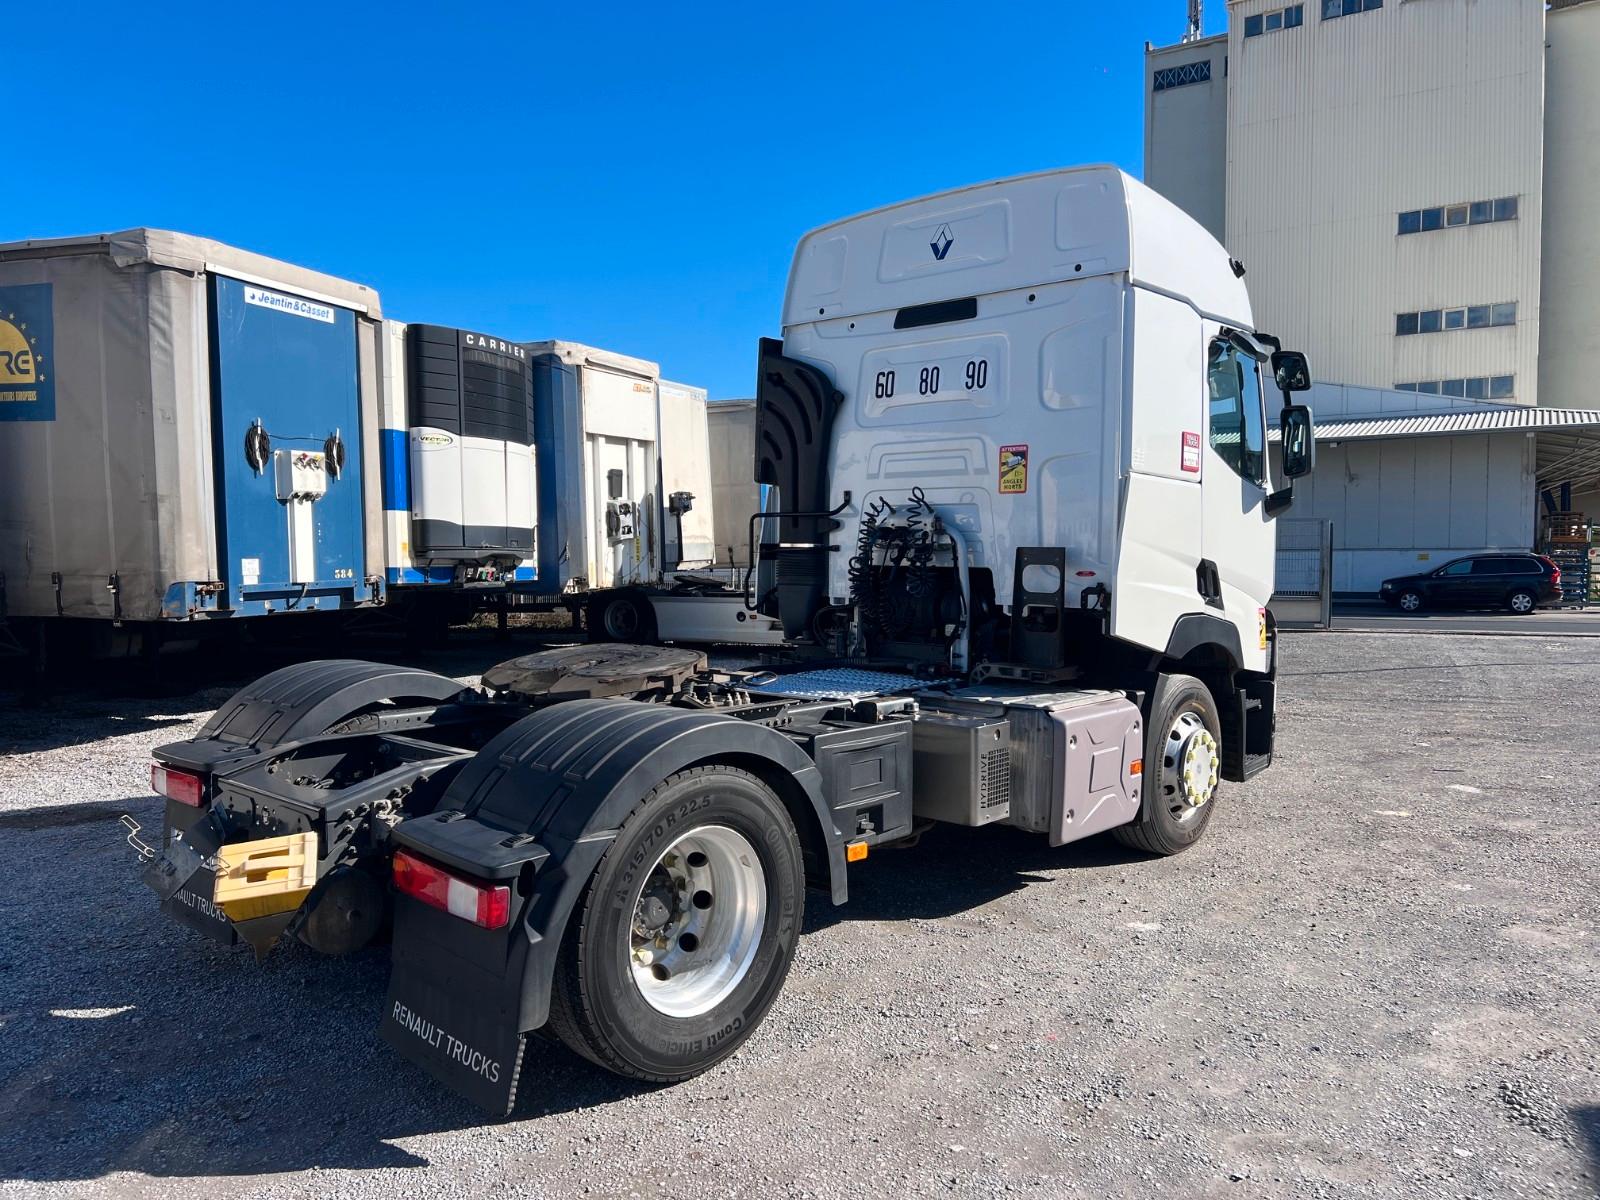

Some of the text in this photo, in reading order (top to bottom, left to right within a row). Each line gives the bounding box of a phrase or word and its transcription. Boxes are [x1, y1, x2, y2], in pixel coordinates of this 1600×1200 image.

[875, 360, 988, 399] 60 80 90
[622, 796, 711, 884] 315/70 R 22.5
[392, 1000, 500, 1083] RENAULT TRUCKS
[706, 1017, 743, 1049] Conti
